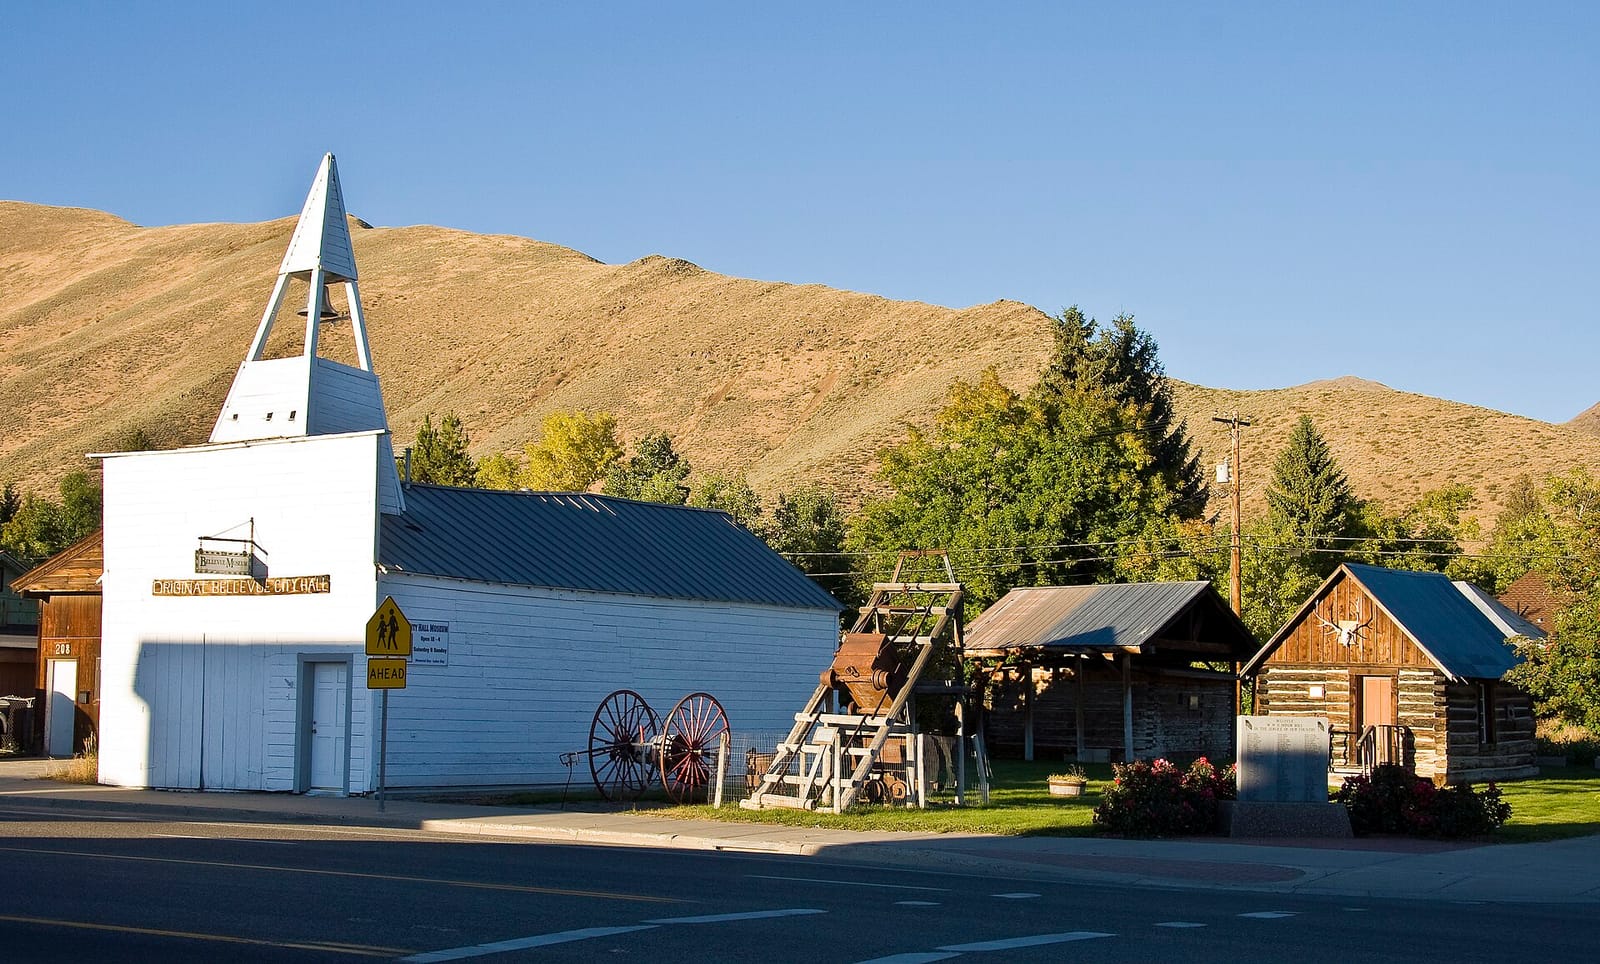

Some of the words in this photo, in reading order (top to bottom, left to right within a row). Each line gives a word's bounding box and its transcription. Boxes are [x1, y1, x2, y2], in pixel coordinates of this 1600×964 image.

[153, 580, 208, 594] ORIGINAL
[212, 580, 270, 593] BELLEVUE
[274, 579, 300, 593] CITY
[300, 576, 329, 592] HALL
[55, 643, 70, 655] 208
[370, 667, 405, 680] AHEAD
